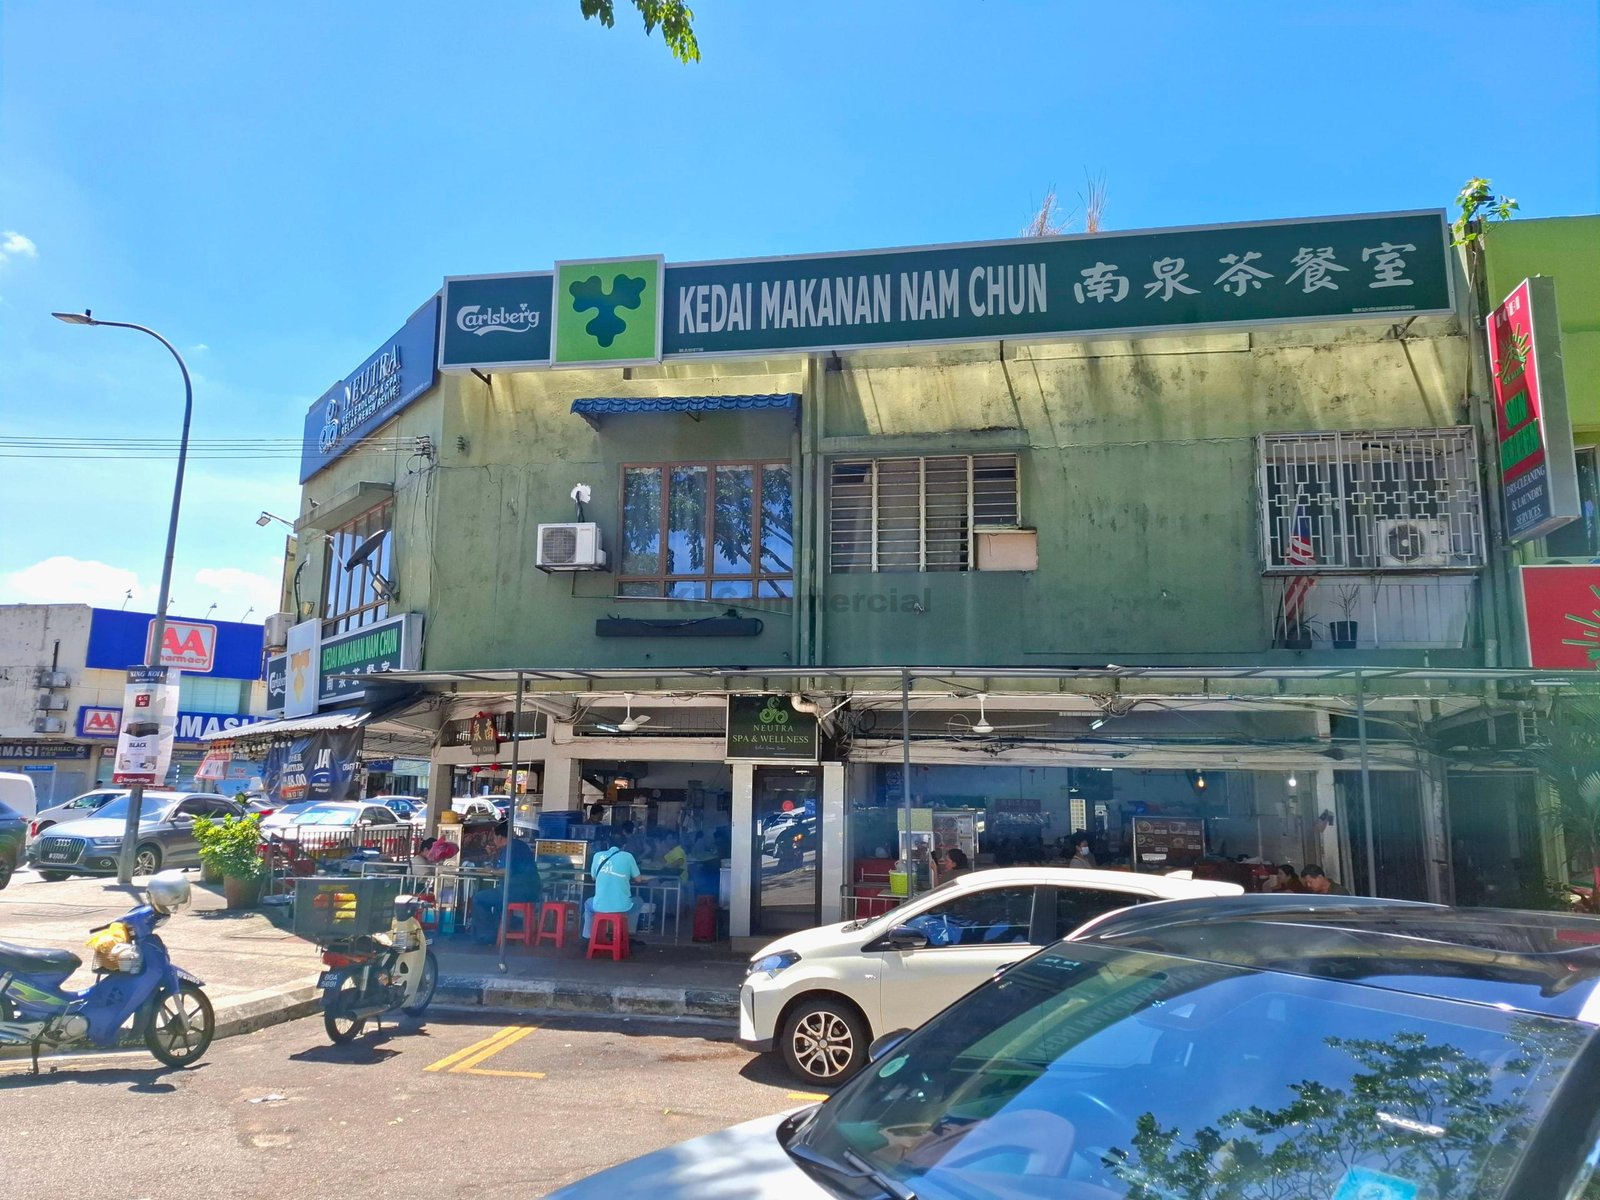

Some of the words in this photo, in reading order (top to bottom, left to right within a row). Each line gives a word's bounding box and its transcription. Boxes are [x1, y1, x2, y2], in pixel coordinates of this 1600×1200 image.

[1073, 242, 1417, 304] 南泉茶餐室
[679, 283, 752, 334] KEDAI
[761, 273, 891, 329] MAKANAN
[901, 268, 959, 321] NAM
[969, 263, 1047, 317] CHUN
[456, 303, 541, 335] Carlsberg
[344, 345, 402, 412] NEUTRA
[1506, 464, 1545, 497] DRY-CLEANING
[1516, 484, 1543, 508] LAUNDRY
[1515, 503, 1541, 526] SERVICES
[365, 633, 380, 660] NAM
[380, 627, 398, 657] CHUN
[160, 654, 209, 666] harmacy
[86, 712, 116, 729] AA
[753, 724, 794, 732] NEUTRA
[0, 745, 38, 757] MASI
[732, 734, 749, 743] SPA
[751, 735, 758, 743] &
[760, 735, 809, 744] WELLNESS
